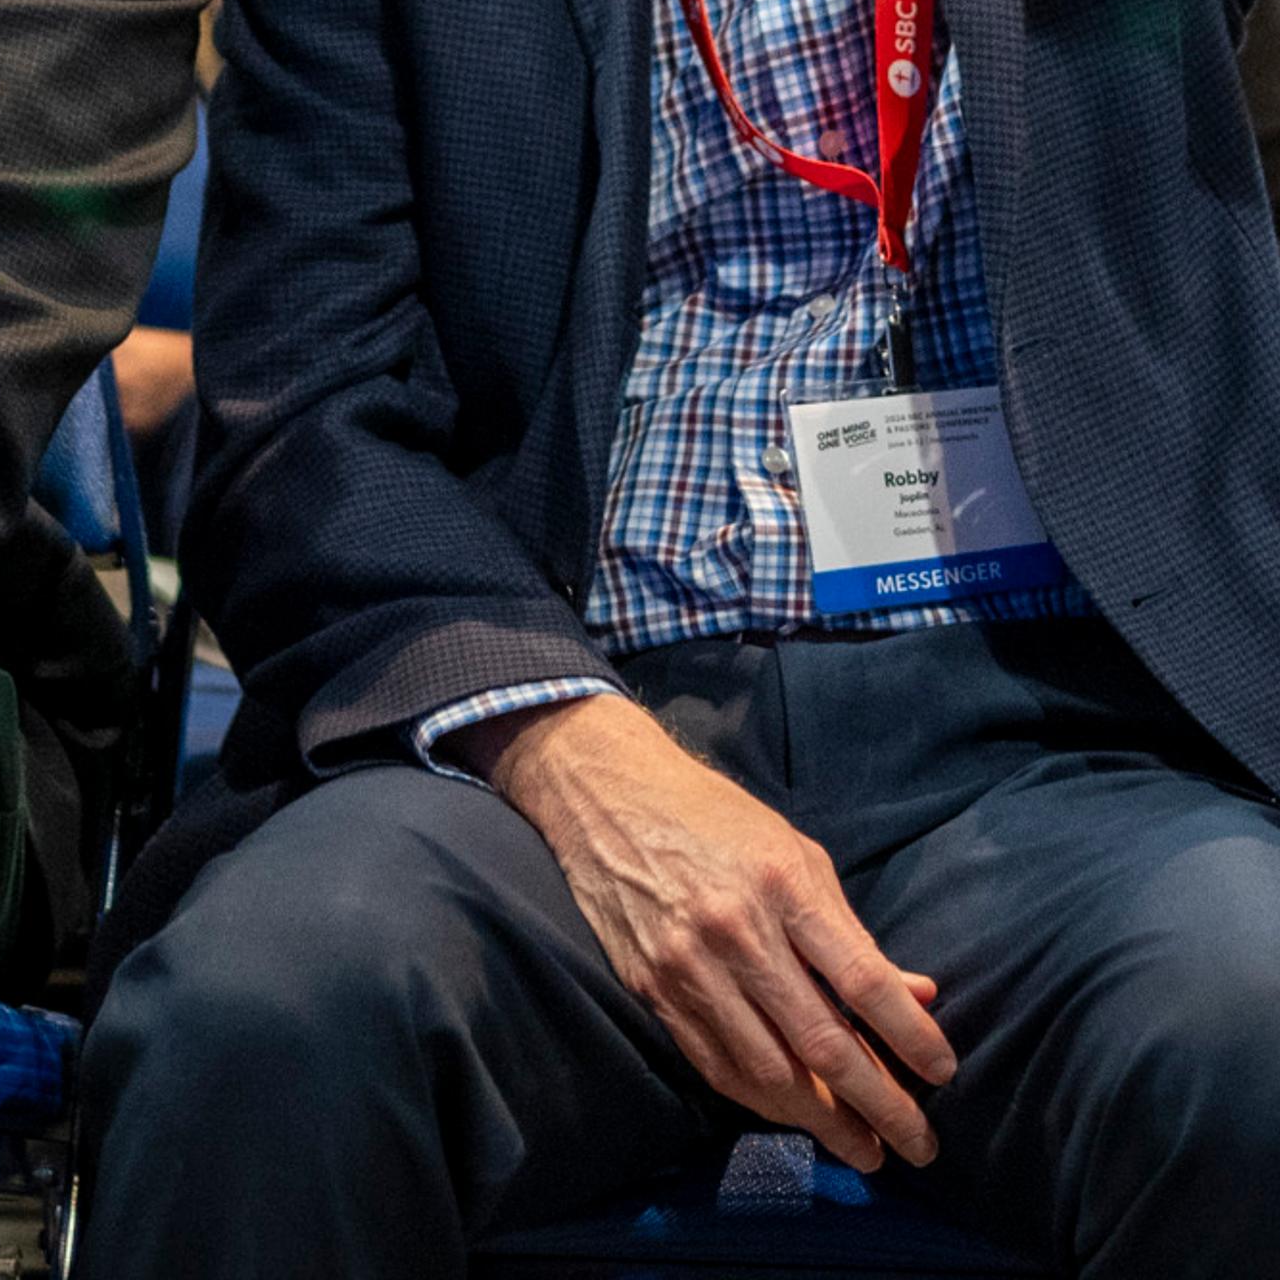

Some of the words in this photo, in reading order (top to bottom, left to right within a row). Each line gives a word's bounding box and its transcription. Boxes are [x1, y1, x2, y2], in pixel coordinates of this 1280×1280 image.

[895, 0, 918, 54] SBC
[817, 427, 839, 440] ONE
[842, 420, 870, 434] MIND
[818, 438, 840, 451] ONE
[844, 429, 877, 444] VOICE
[883, 468, 939, 487] Robby
[876, 561, 1002, 595] MESSENGER
